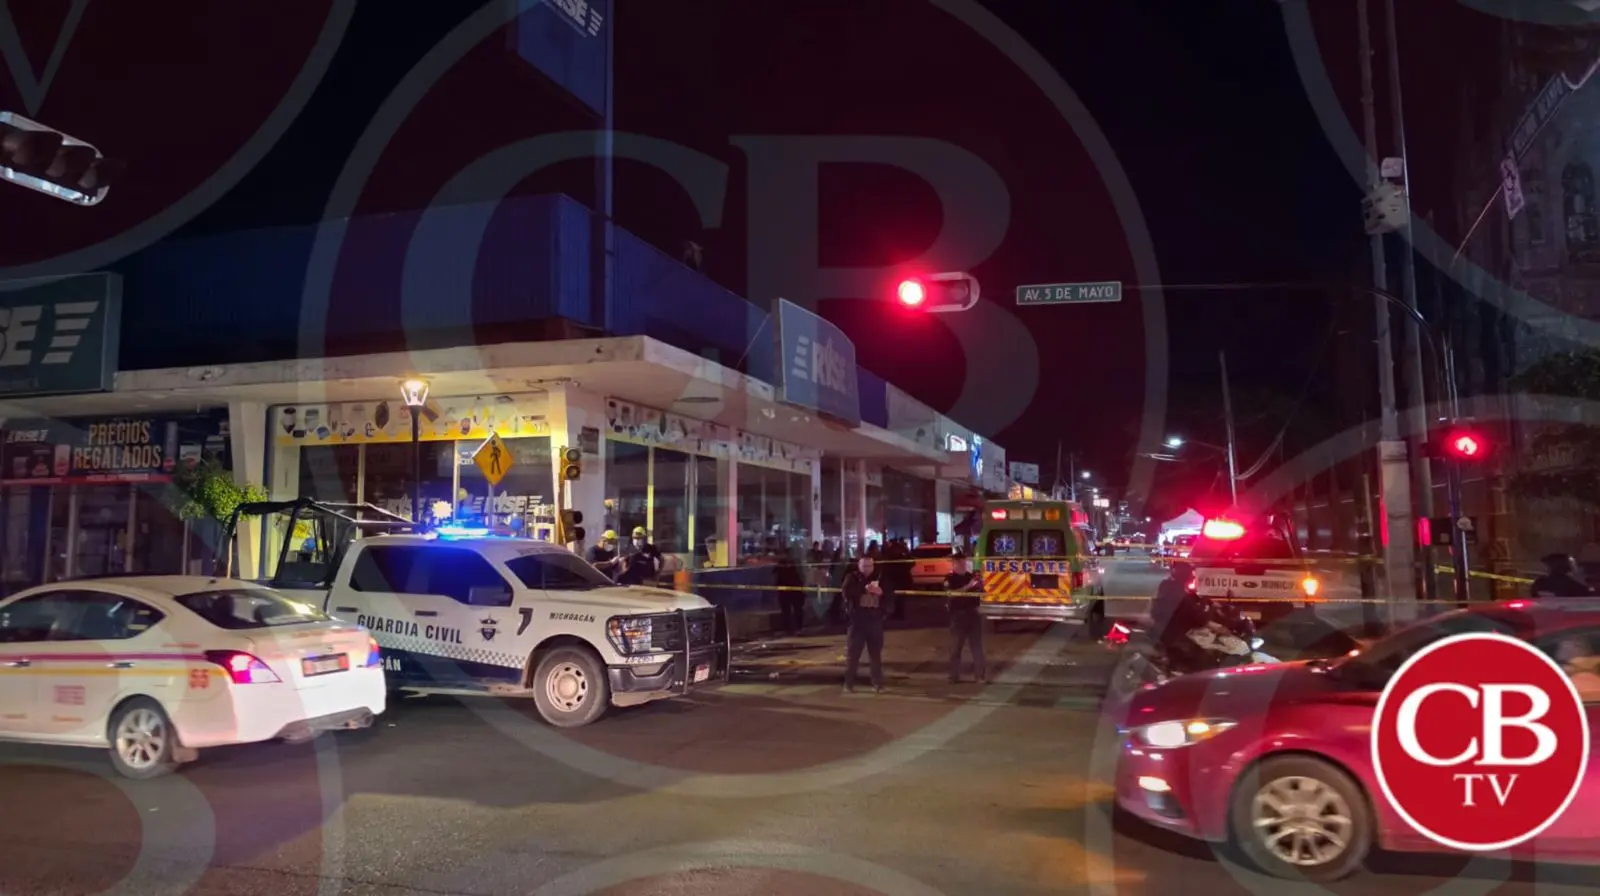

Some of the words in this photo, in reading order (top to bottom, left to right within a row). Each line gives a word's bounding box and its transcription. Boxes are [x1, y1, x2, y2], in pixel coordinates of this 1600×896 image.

[1025, 288, 1042, 301] AV.
[1045, 288, 1052, 300] 5
[1055, 287, 1072, 299] DE
[1079, 286, 1114, 299] MAYO
[89, 420, 151, 445] PRECIOS
[73, 445, 163, 469] REGALADOS
[985, 560, 1067, 573] RESCATE
[357, 614, 419, 637] GUARDIA
[425, 625, 463, 644] CIVIL
